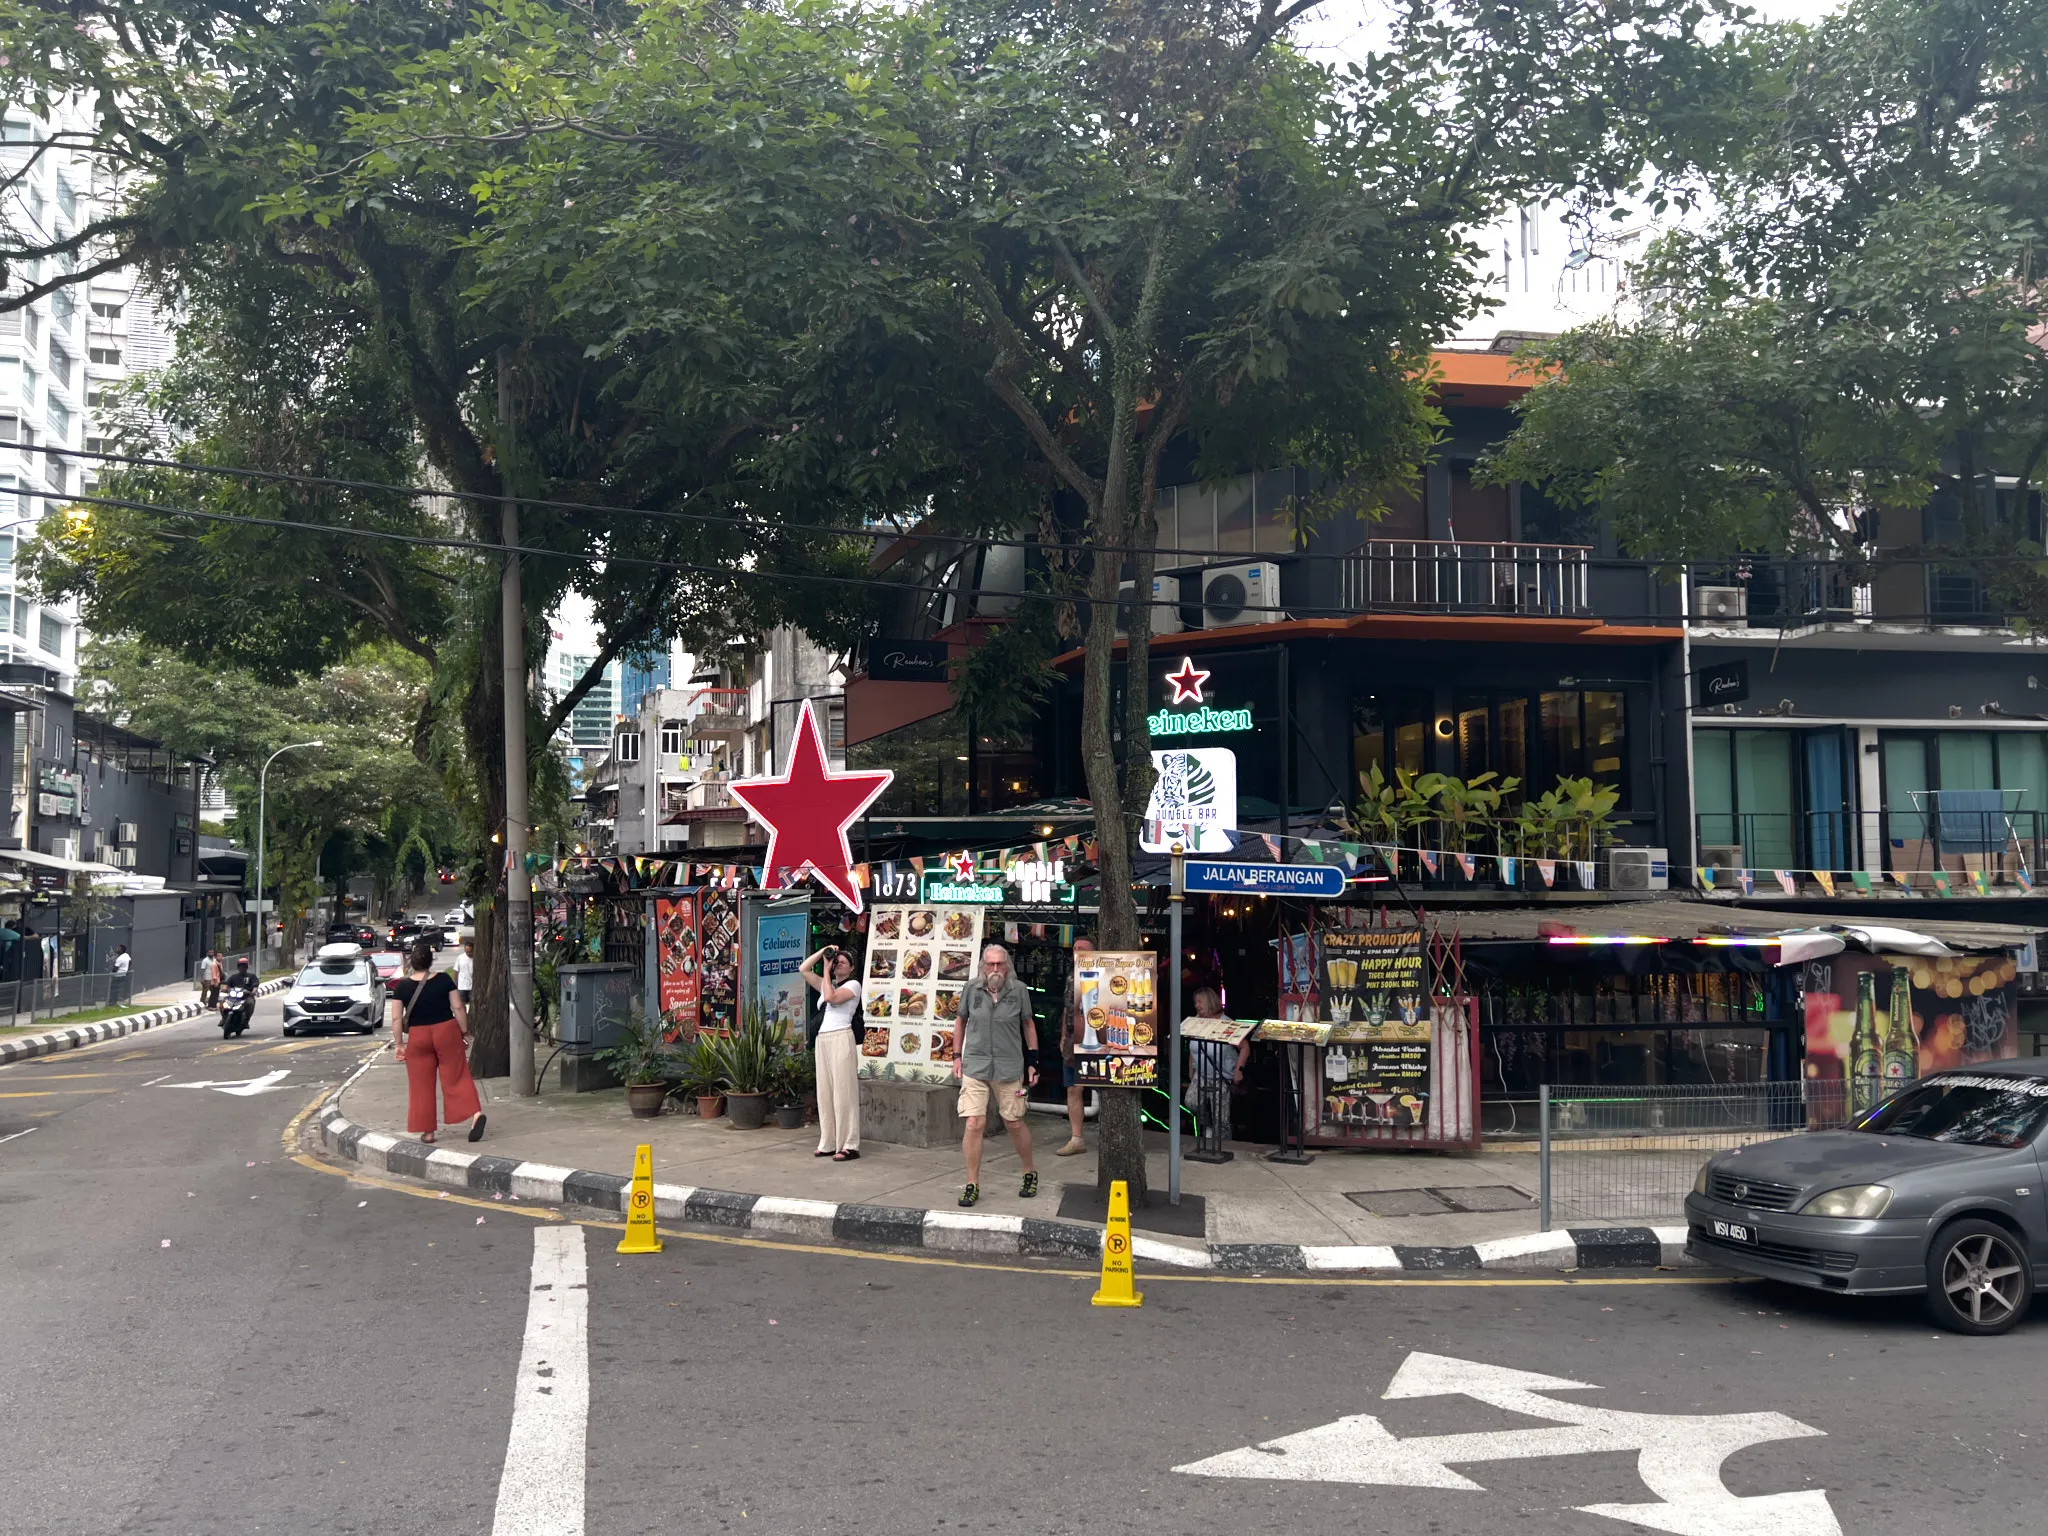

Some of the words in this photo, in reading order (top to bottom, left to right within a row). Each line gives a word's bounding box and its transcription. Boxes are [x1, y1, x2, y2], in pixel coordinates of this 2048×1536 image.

[884, 652, 934, 669] Reuben's
[1147, 706, 1254, 736] eineken
[1156, 808, 1192, 820] JUNGLE
[1198, 808, 1217, 820] BAR
[1203, 867, 1246, 882] JALAN
[1250, 870, 1324, 885] BERANGAN
[929, 882, 1004, 902] Heineken
[763, 937, 801, 950] Edelweiss
[1323, 933, 1355, 946] CRAZY
[1358, 931, 1421, 947] PROMOTION
[1361, 958, 1393, 970] HAPPY
[1395, 956, 1423, 969] HOUR
[669, 996, 697, 1010] Special
